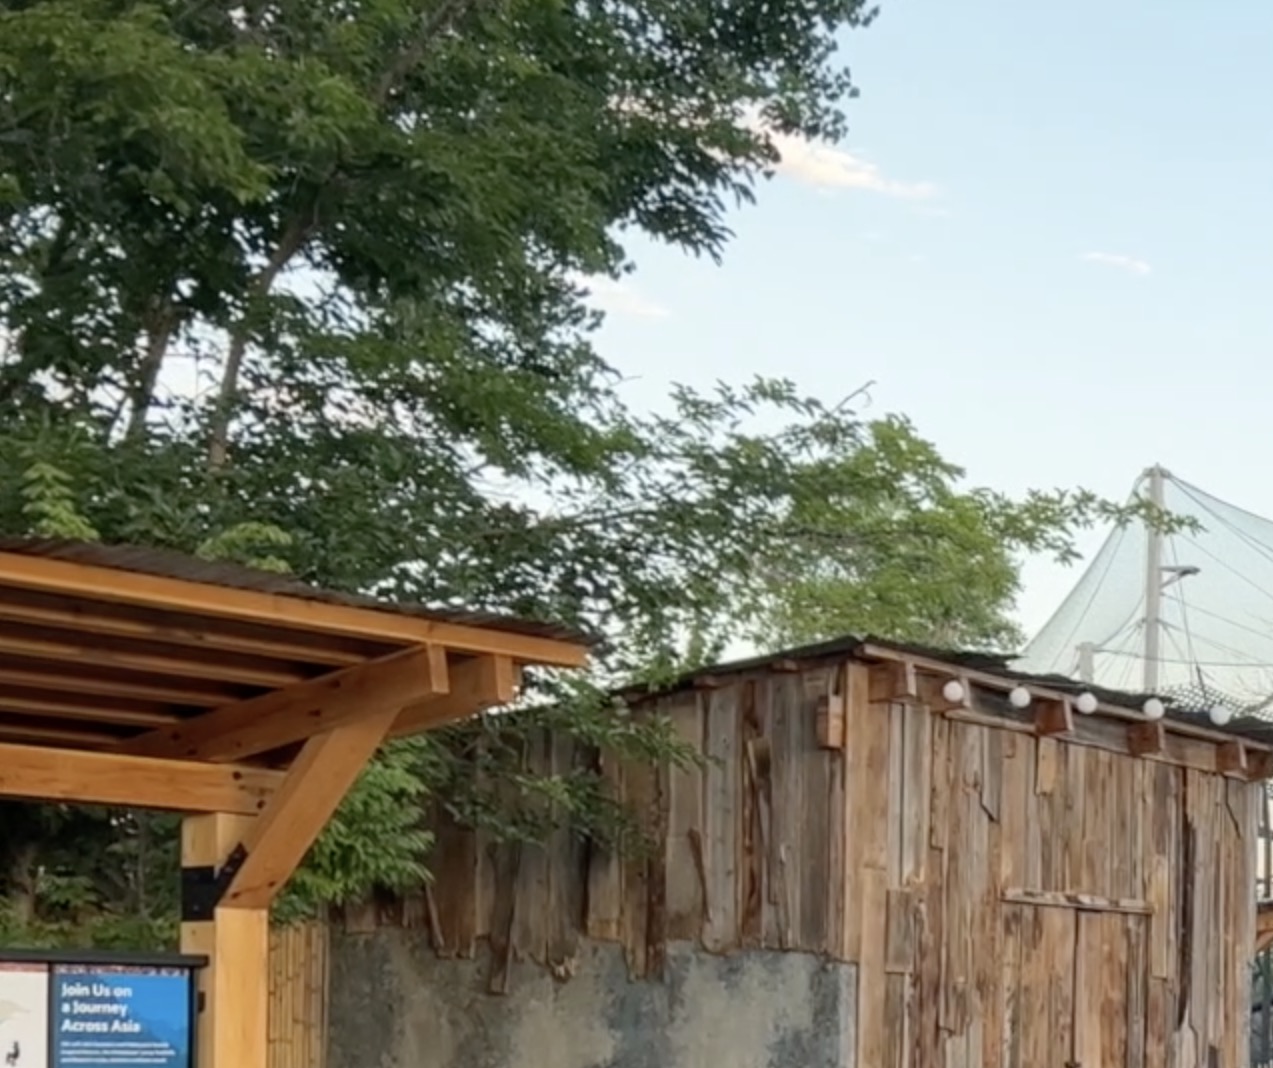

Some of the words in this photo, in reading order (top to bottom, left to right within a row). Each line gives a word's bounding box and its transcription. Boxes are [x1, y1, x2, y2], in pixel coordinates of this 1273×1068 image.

[61, 983, 90, 998] Join
[92, 983, 111, 998] Us
[113, 987, 133, 998] on
[61, 1002, 70, 1013] a
[73, 1000, 128, 1017] Journey
[61, 1019, 109, 1032] Across
[111, 1019, 141, 1032] Asia
